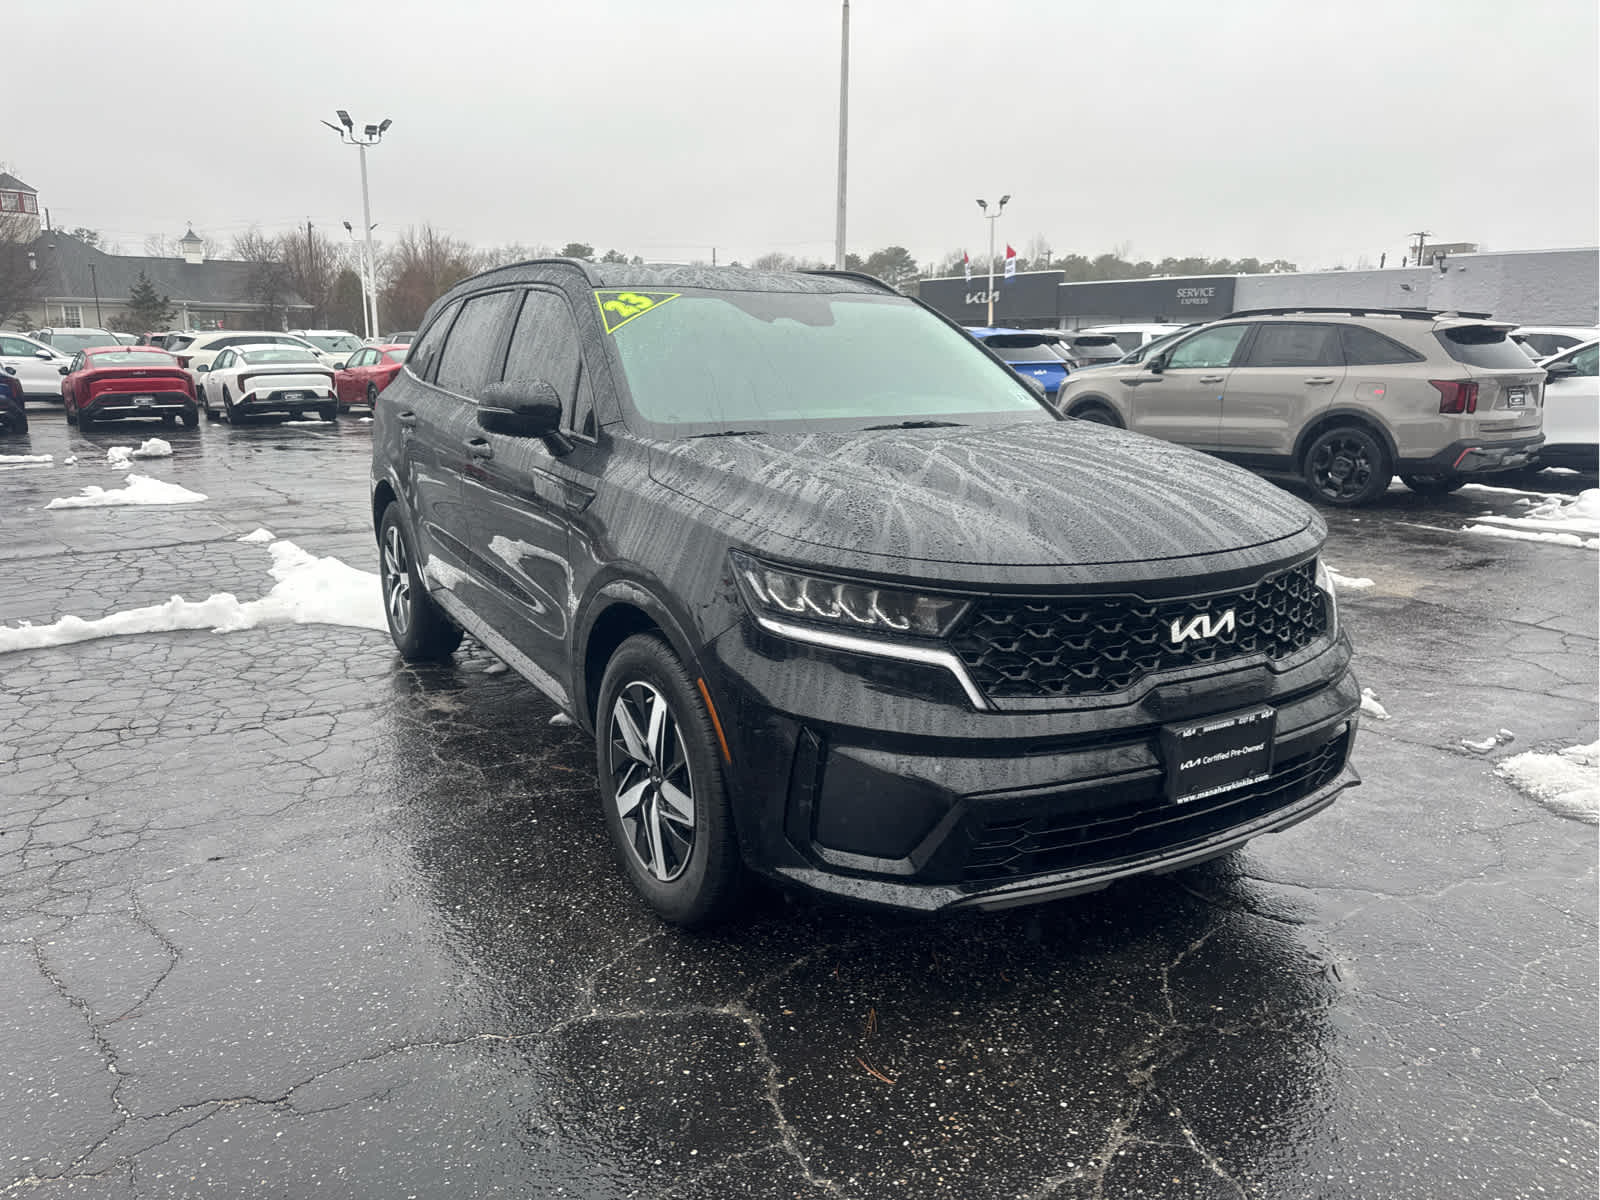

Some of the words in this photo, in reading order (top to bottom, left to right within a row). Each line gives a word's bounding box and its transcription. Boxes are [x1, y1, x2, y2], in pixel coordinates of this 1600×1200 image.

[603, 293, 654, 317] 23
[965, 290, 1000, 304] KIA
[1176, 287, 1215, 297] SERVICE
[1170, 608, 1236, 643] KIA
[1179, 758, 1201, 771] KIA
[1202, 752, 1230, 764] Certified
[1230, 743, 1265, 758] Pre-Owned
[1177, 775, 1270, 804] www.manahawkinkia.com
